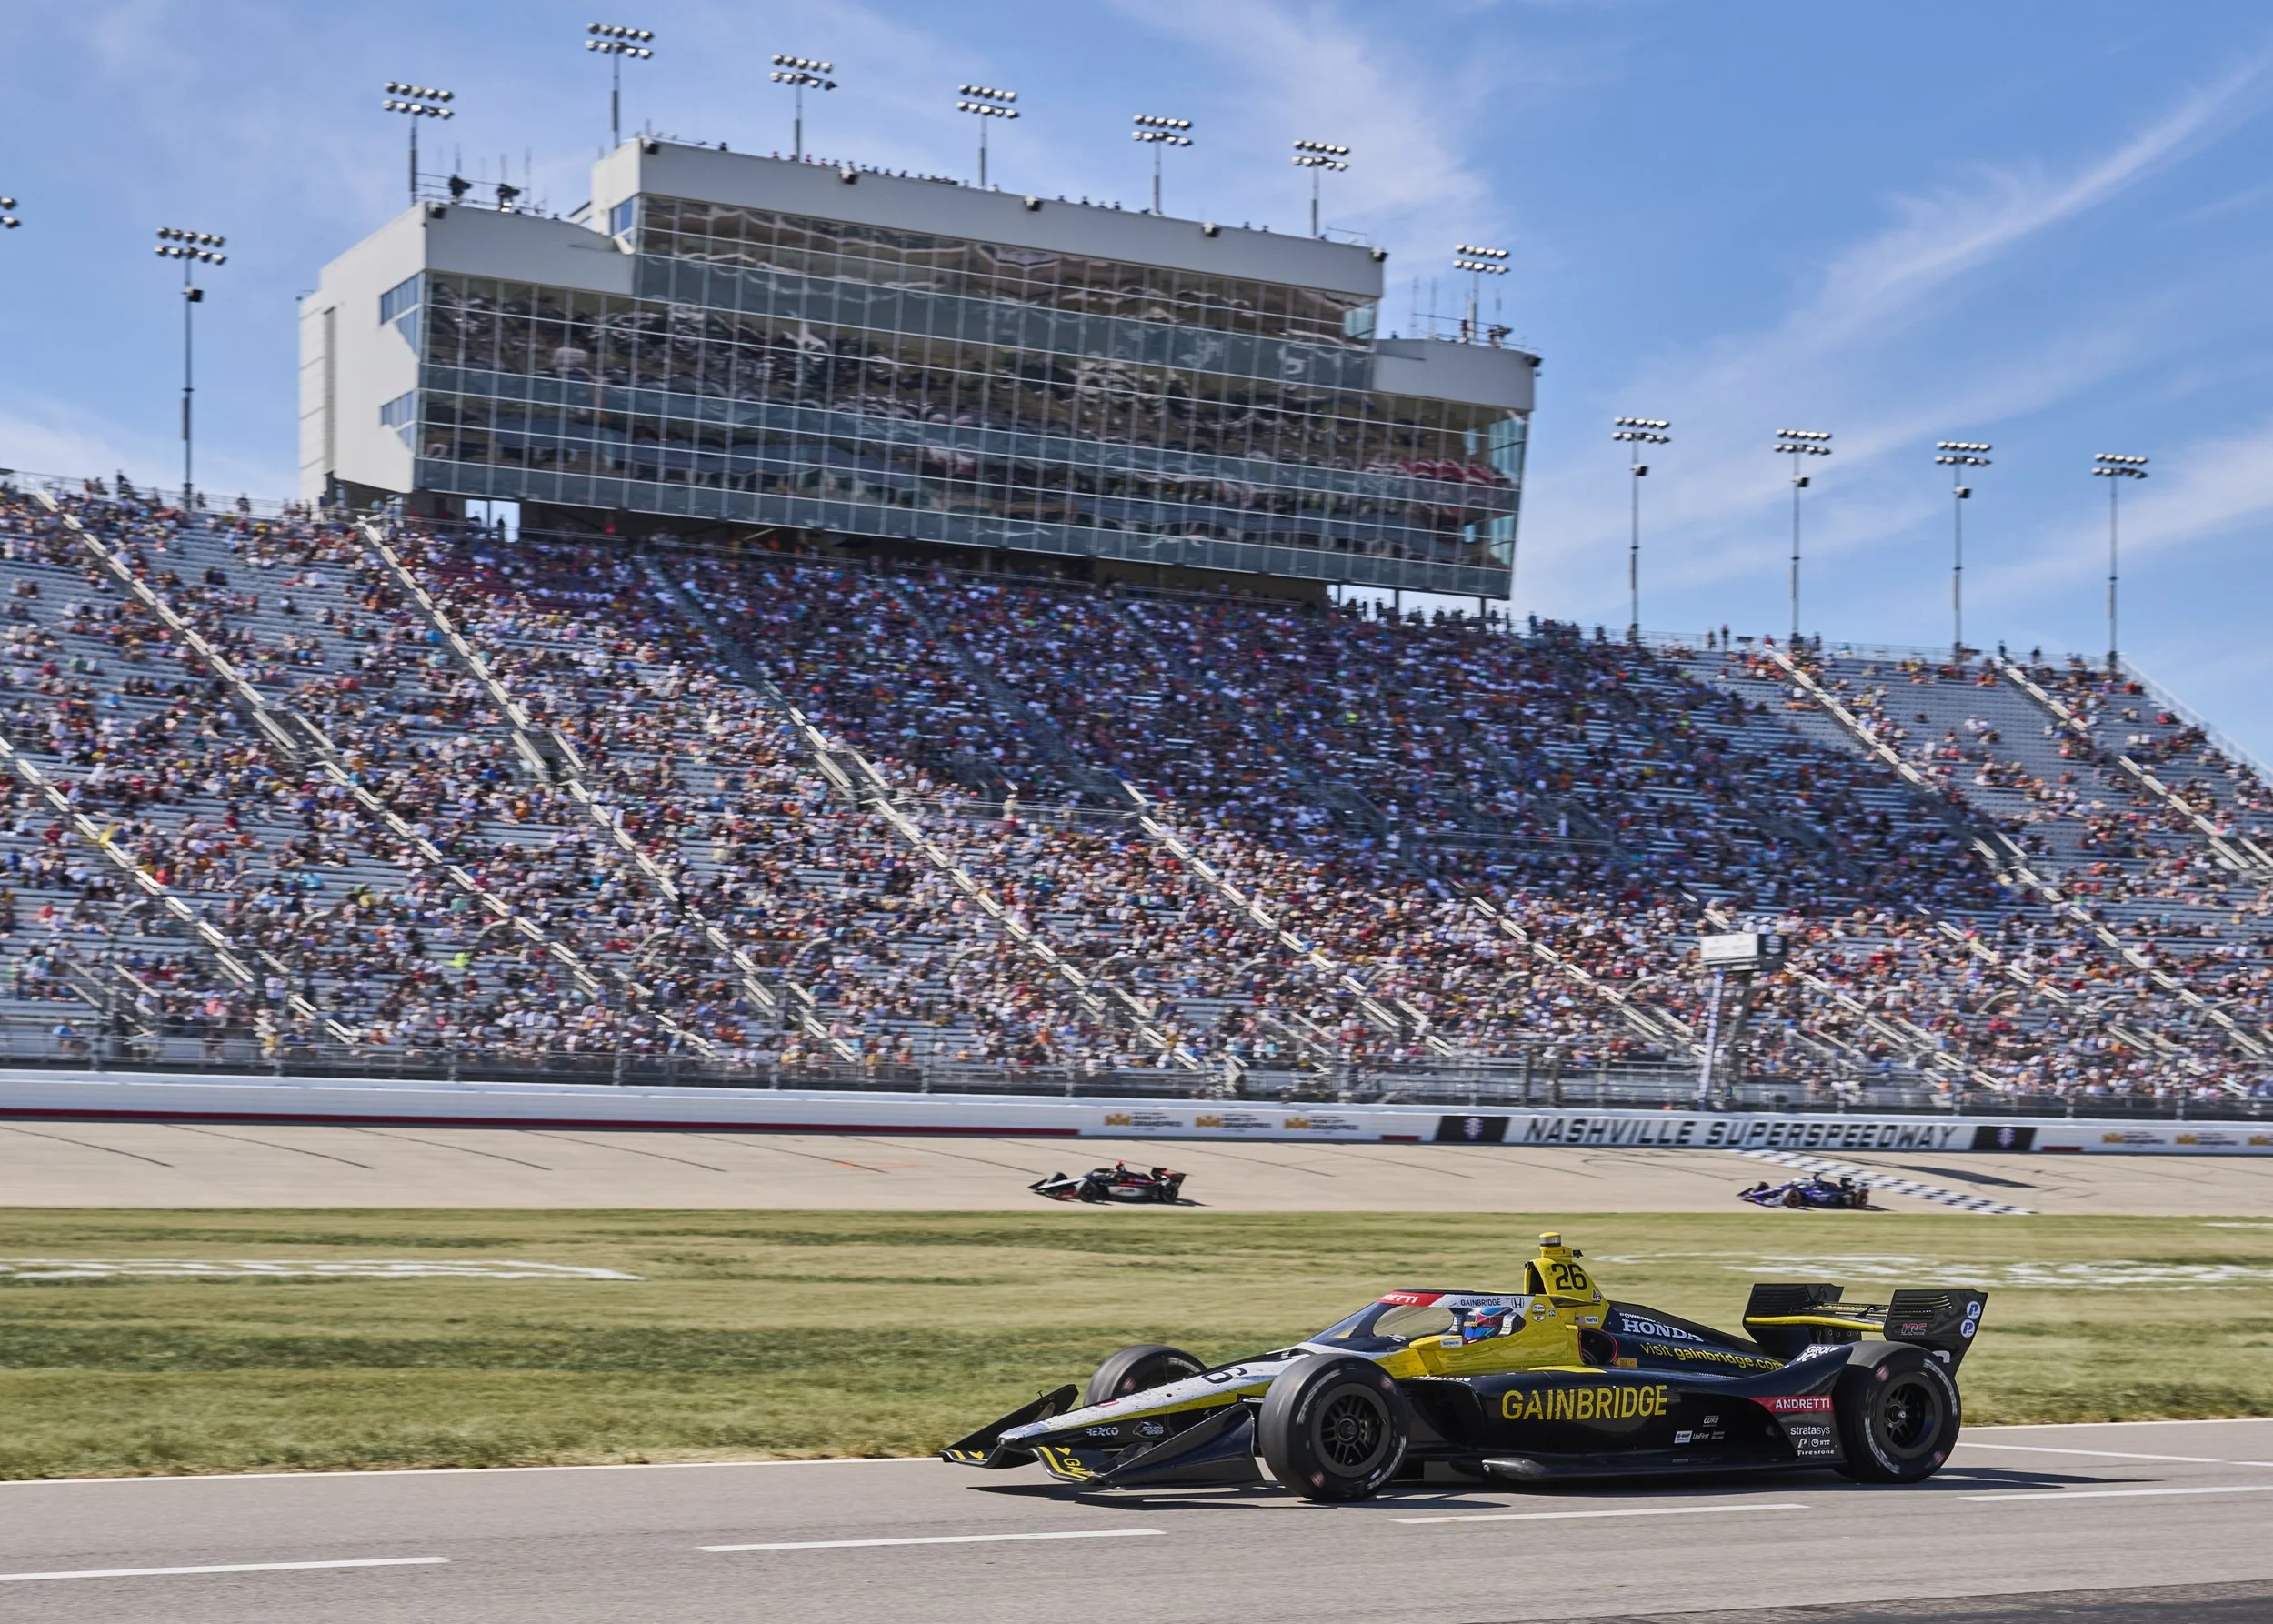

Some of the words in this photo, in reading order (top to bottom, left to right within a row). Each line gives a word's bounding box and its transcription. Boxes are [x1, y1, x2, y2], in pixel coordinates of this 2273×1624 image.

[1523, 1118, 1697, 1144] NASHVILLE
[1705, 1121, 1958, 1148] SUPERSPEEDWAY
[1551, 1263, 1587, 1290] 26
[1622, 1318, 1705, 1342] HONDA
[1640, 1342, 1673, 1357] visit
[1502, 1385, 1668, 1420] GAINBRIDGE
[1775, 1398, 1830, 1409] ANDRETTI
[1790, 1426, 1831, 1436] stratasys
